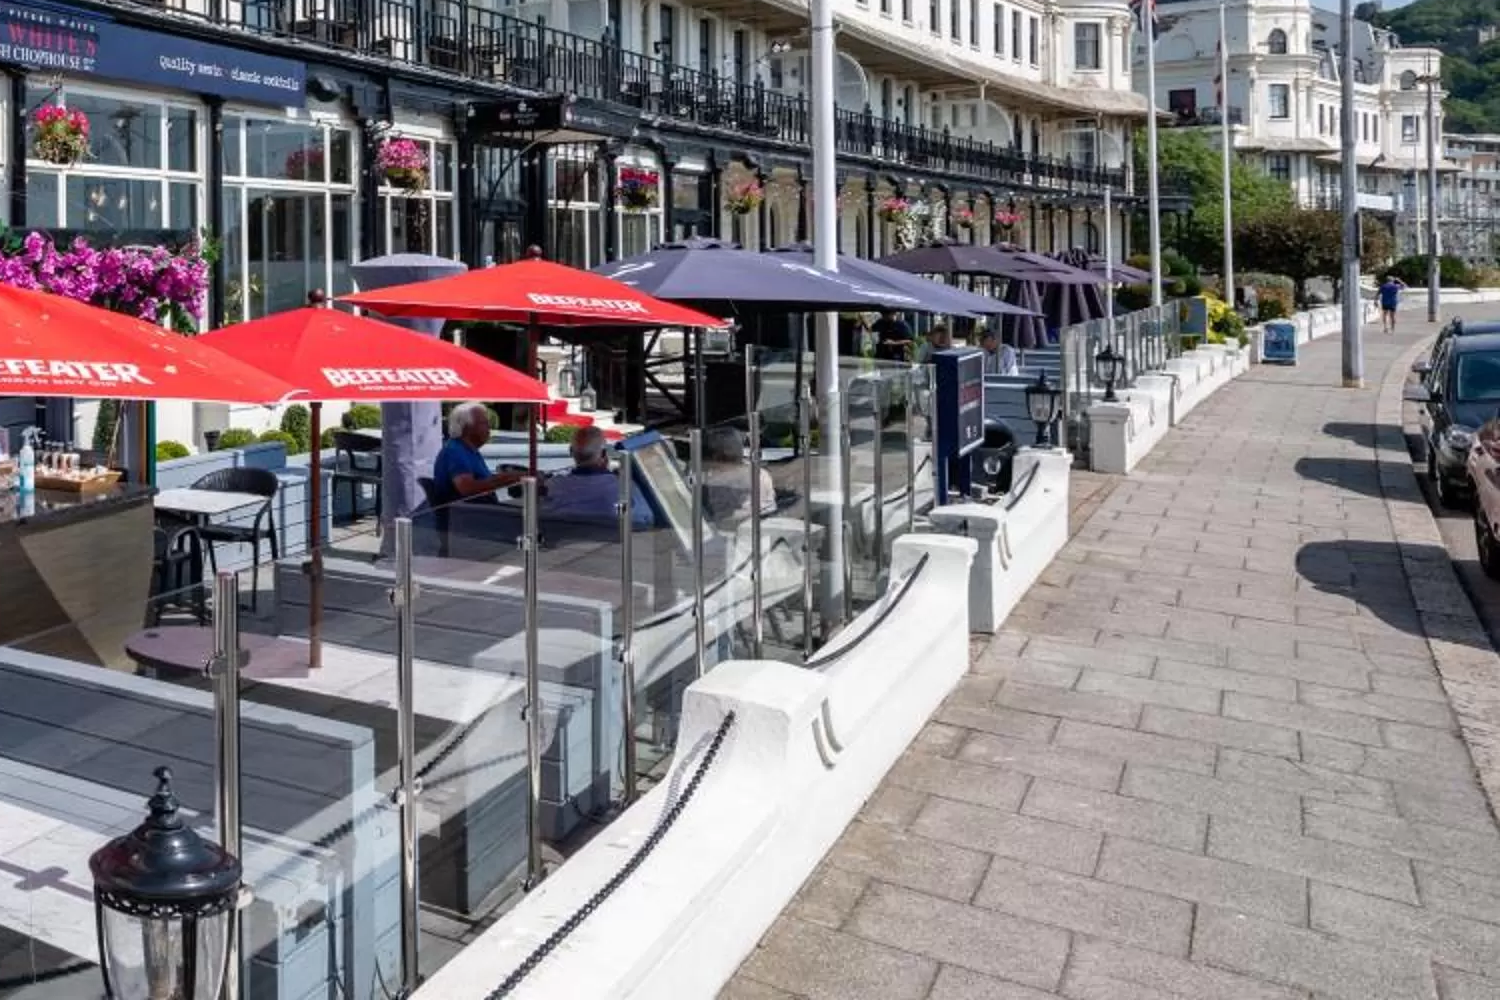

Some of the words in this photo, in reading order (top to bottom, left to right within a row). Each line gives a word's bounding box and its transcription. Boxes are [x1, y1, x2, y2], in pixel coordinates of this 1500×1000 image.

[13, 46, 80, 71] CHOPHOUSE
[159, 55, 195, 76] Quality
[527, 292, 650, 314] BEEFEATER
[320, 367, 472, 389] BEEFEATER
